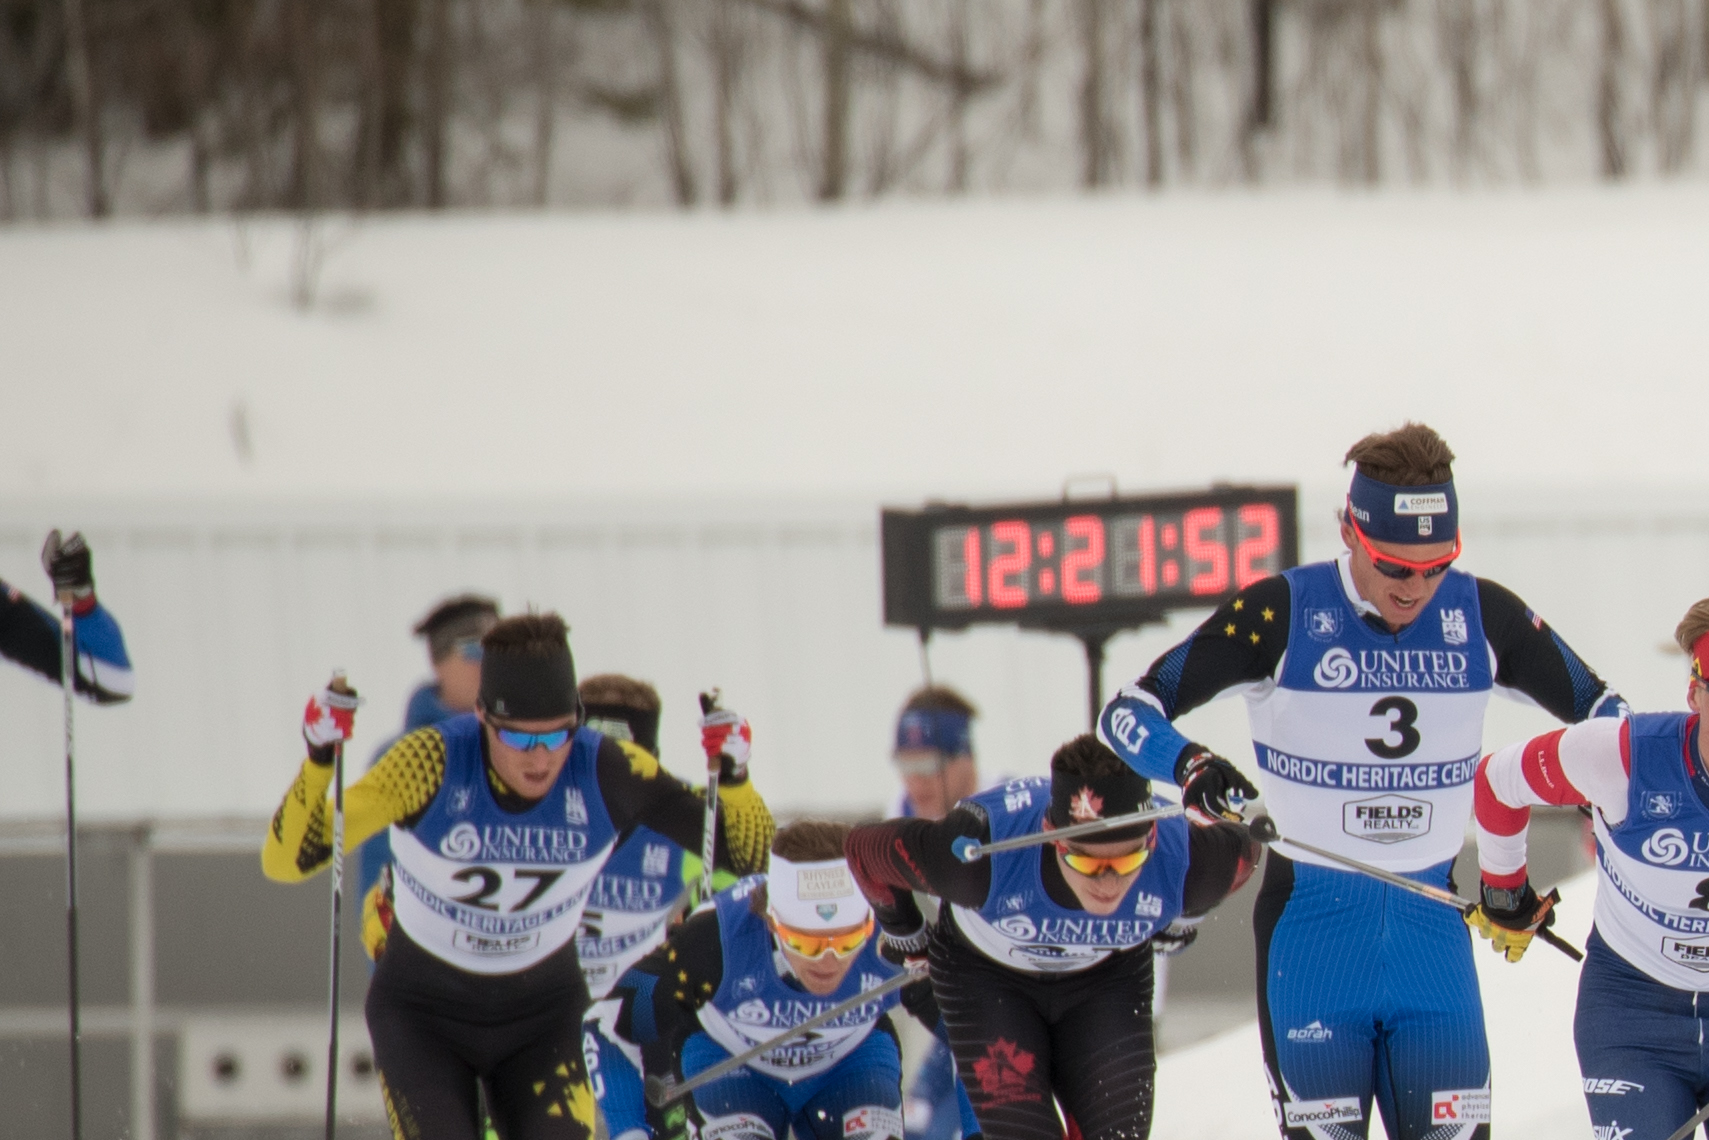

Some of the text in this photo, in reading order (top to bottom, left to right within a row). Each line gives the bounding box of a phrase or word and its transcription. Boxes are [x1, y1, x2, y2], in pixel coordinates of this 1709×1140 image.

[1440, 608, 1465, 622] US
[1360, 650, 1467, 673] UNITED
[1360, 672, 1470, 688] INSURANCE
[1364, 696, 1421, 760] 3
[1267, 749, 1335, 785] NORDIC
[1341, 765, 1435, 789] HERITAGE
[1356, 805, 1423, 820] FIELDS
[1363, 819, 1413, 830] REALTY
[484, 825, 588, 850] UNITED
[481, 846, 586, 861] INSURANCE
[449, 866, 567, 913] 27
[455, 907, 546, 936] HERITAGE
[1041, 918, 1155, 934] UNITED
